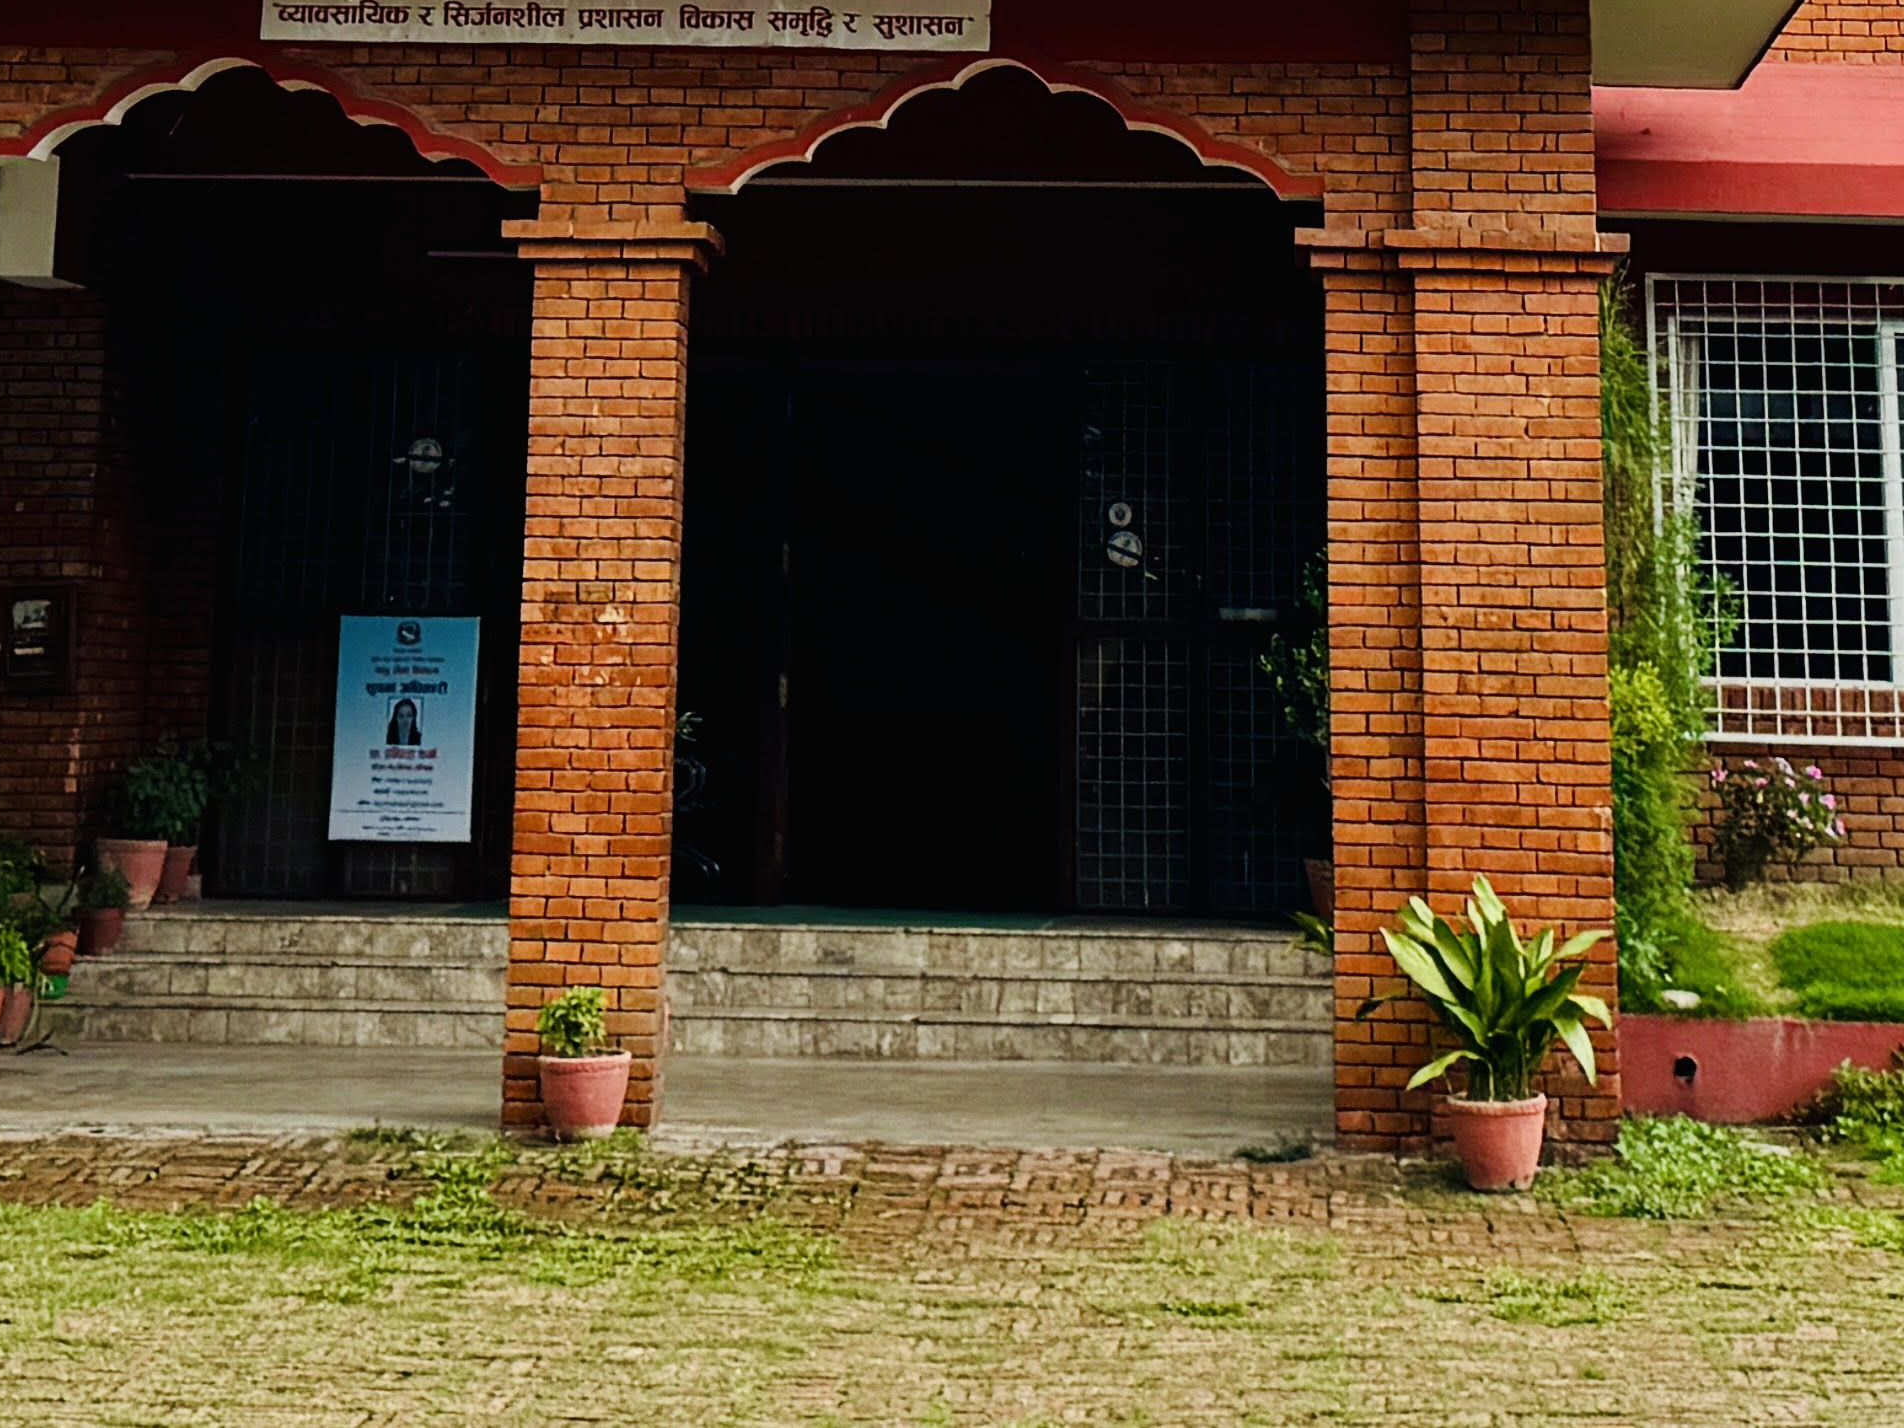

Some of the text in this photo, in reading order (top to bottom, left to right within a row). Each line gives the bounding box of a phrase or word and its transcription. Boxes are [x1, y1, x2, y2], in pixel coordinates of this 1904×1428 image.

[417, 6, 437, 27] र
[443, 0, 568, 28] सिर्जनशील
[577, 8, 664, 30] प्रशासन
[679, 4, 755, 31] विकास
[842, 12, 862, 33] र
